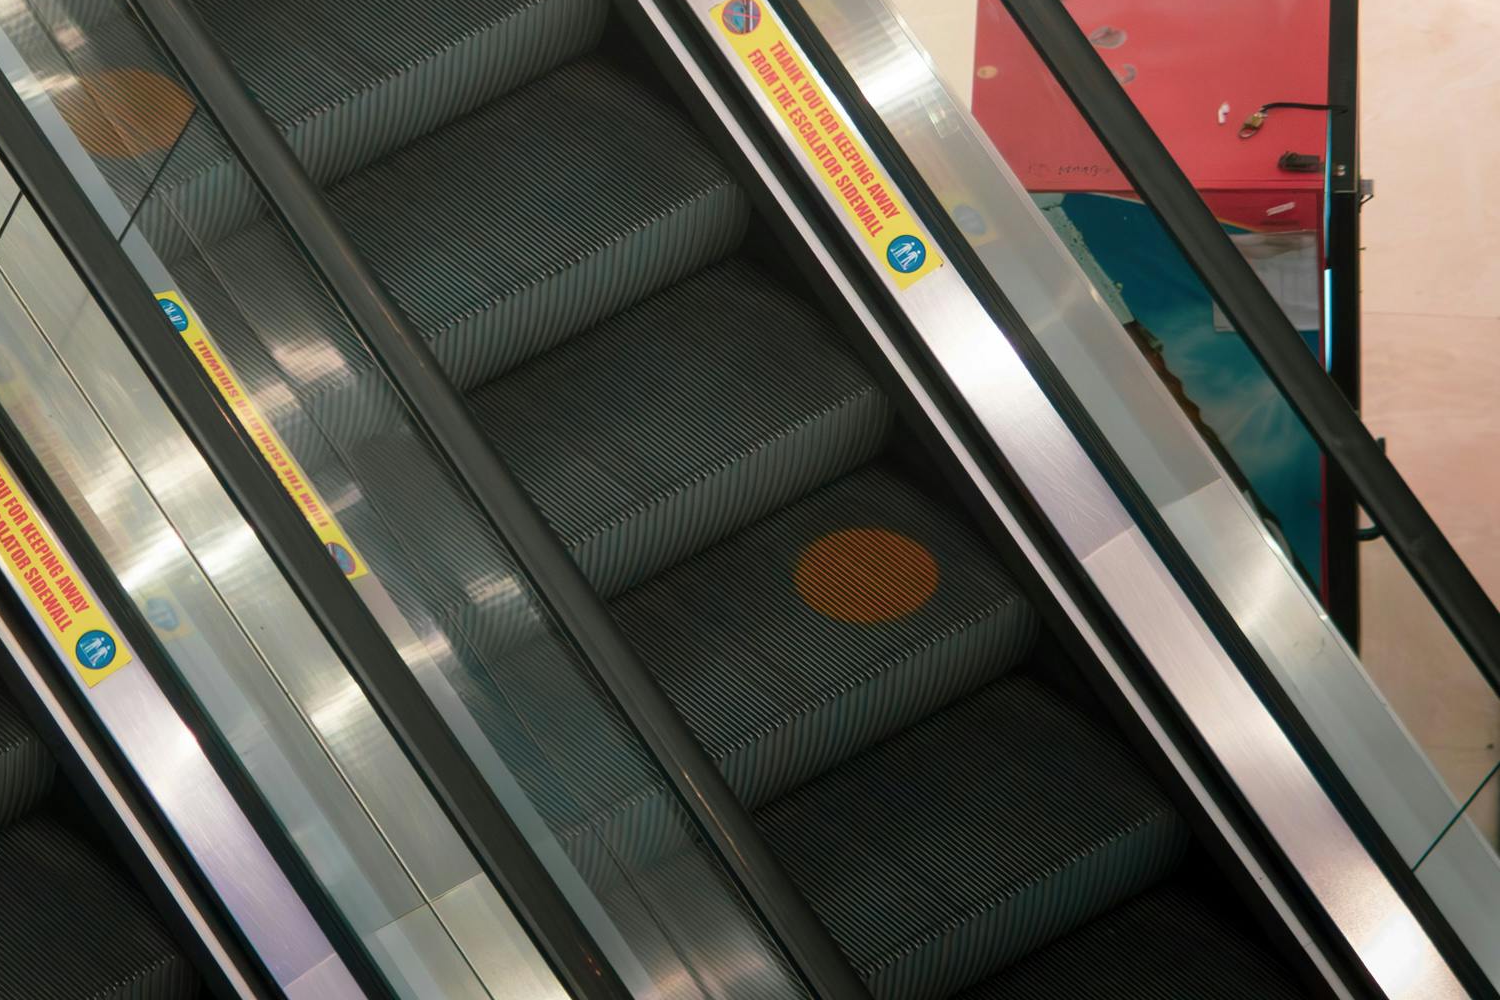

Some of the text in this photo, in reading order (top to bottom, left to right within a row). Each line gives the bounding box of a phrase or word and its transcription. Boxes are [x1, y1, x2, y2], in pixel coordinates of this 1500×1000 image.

[748, 49, 883, 237] FROM THE ESCALATOR SIDEWALL
[770, 41, 900, 219] THANK YOU FOR KEEPING AWAY
[194, 340, 239, 397] SIDEWALL
[284, 468, 303, 491] THE
[300, 492, 330, 527] FROM
[3, 498, 29, 526] FOR
[20, 523, 64, 577] KEEPING
[56, 576, 89, 613] AWAY
[24, 567, 73, 632] SIDEWALL
